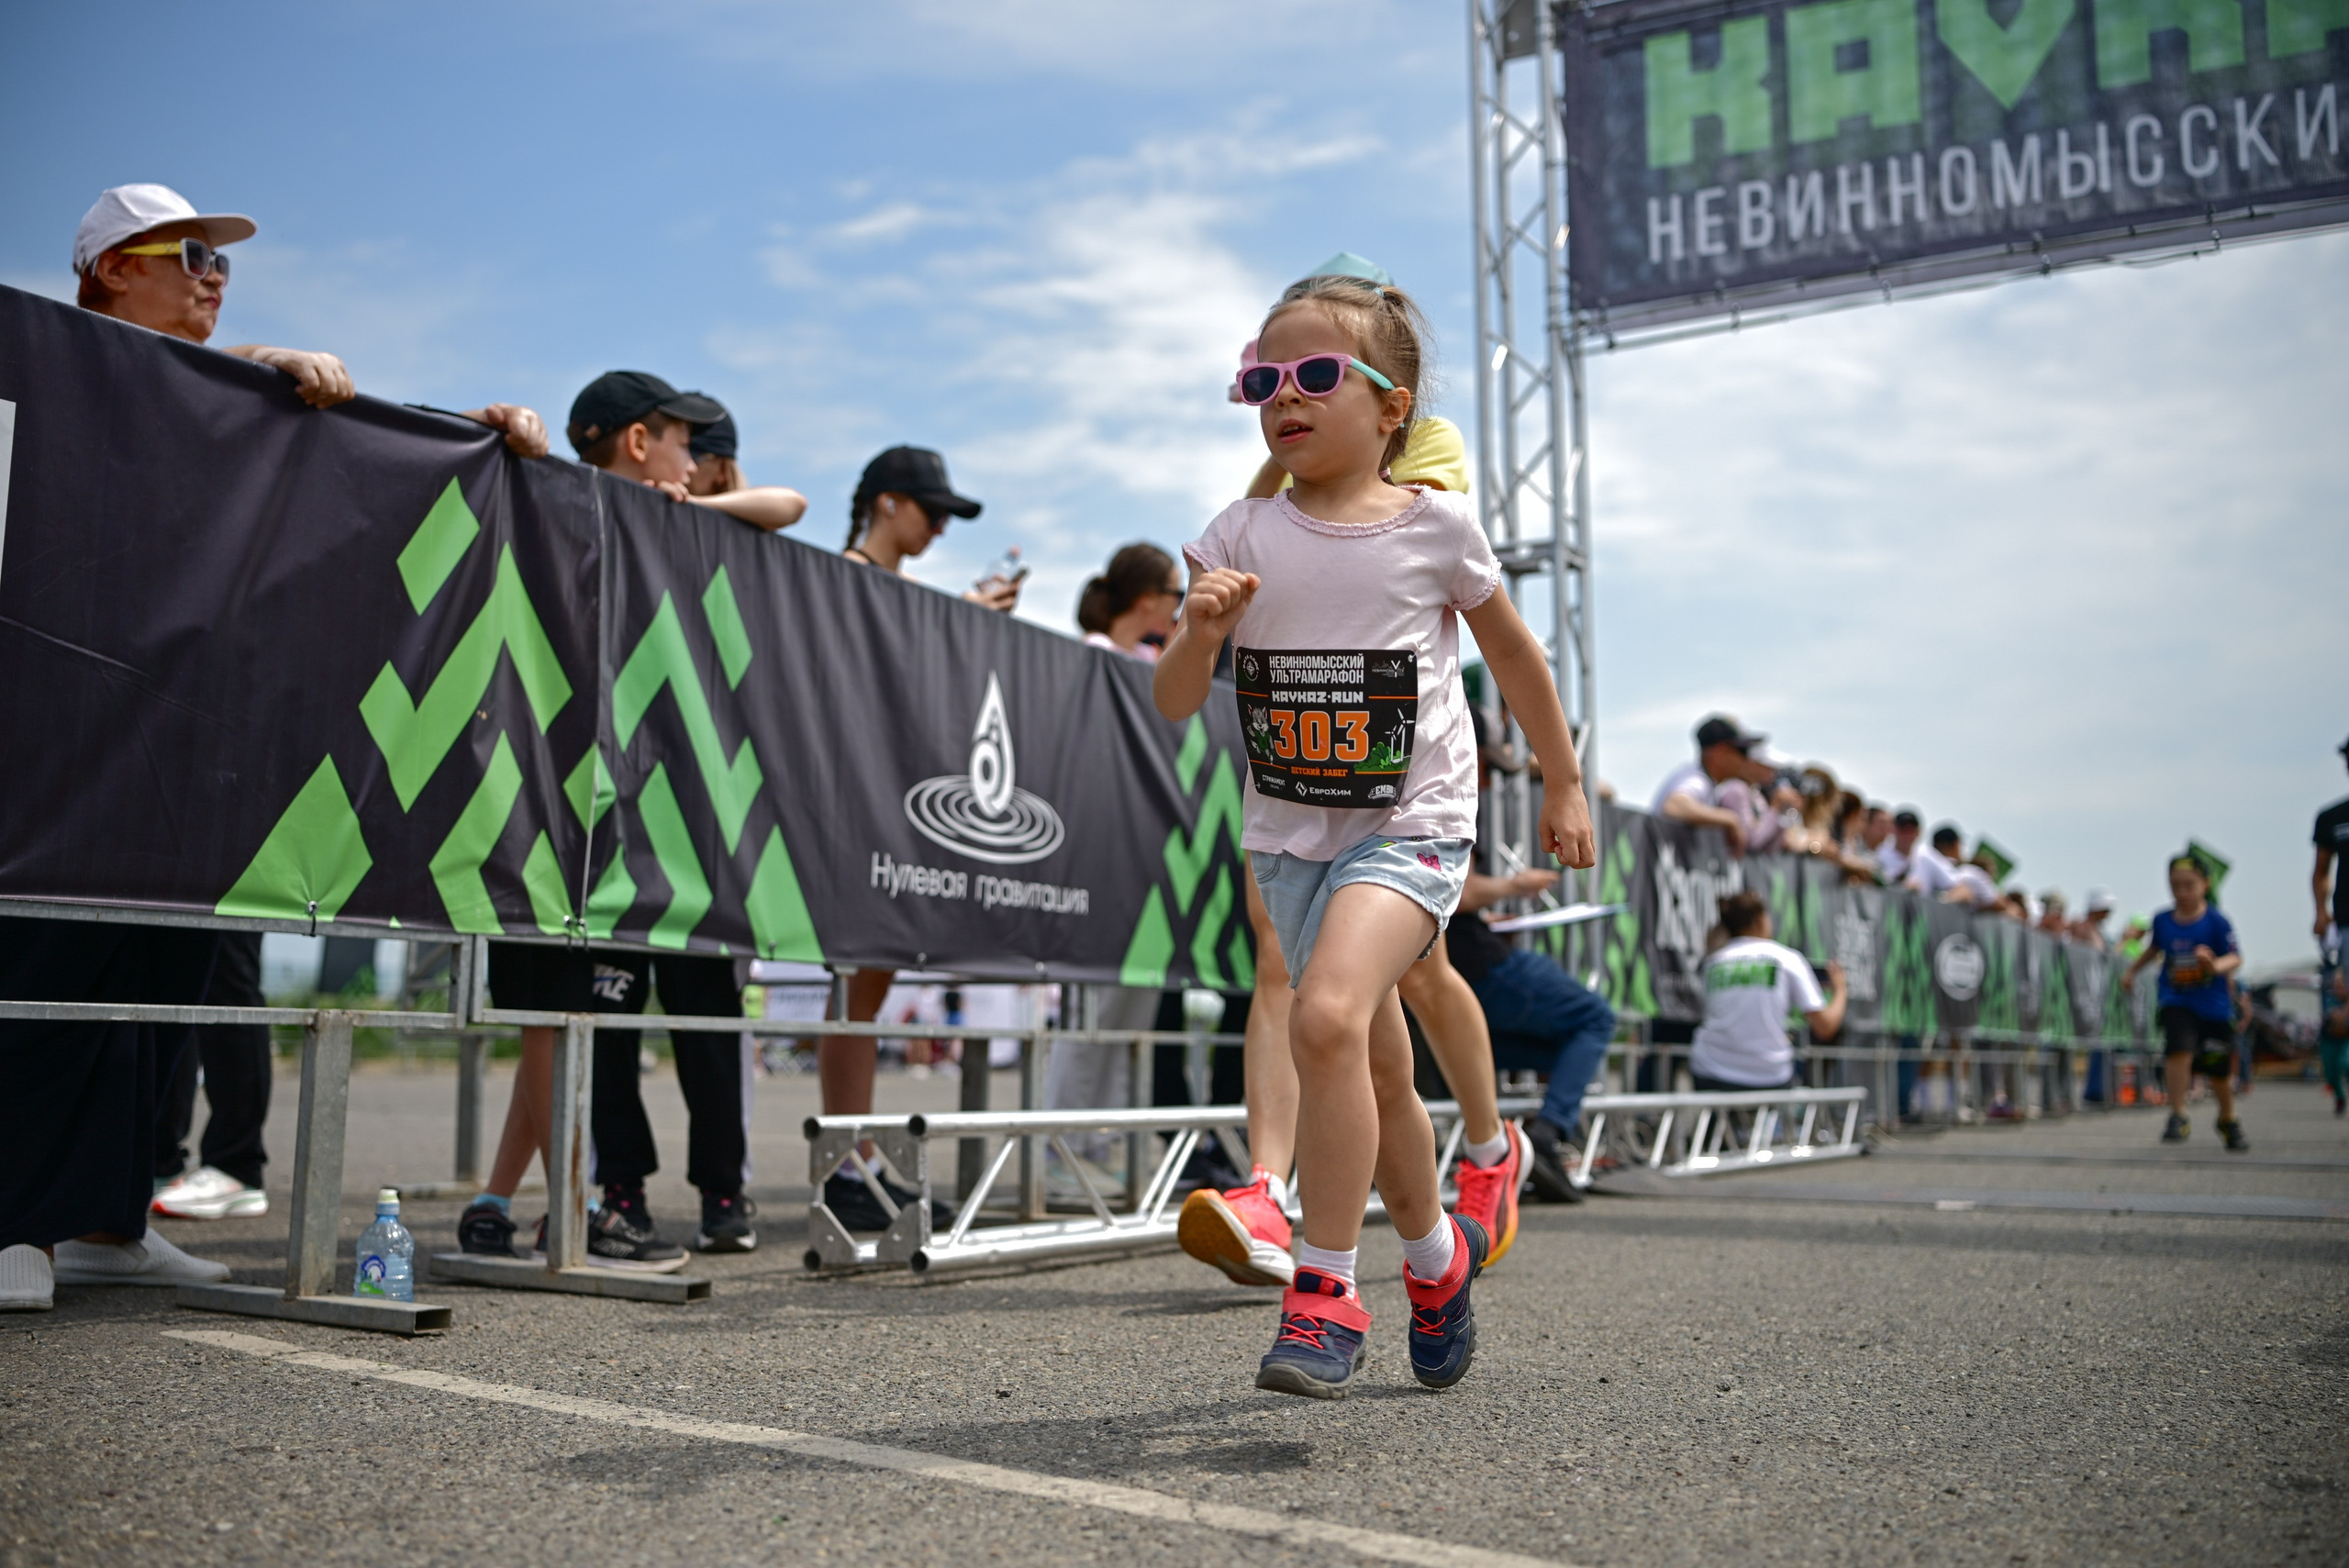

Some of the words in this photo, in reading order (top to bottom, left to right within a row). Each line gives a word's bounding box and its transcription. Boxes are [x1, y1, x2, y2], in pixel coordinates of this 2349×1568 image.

[1269, 653, 1364, 669] НЕВИННОМЫССКИЙ
[1270, 670, 1364, 684] УЛЬТРАМАРАФОН
[1270, 709, 1370, 762] 303
[1290, 766, 1320, 776] ДЕТСКИЙ
[1322, 769, 1349, 777] ЗАБЕГ
[870, 851, 968, 900] Нулевая
[974, 873, 1090, 917] гравитация
